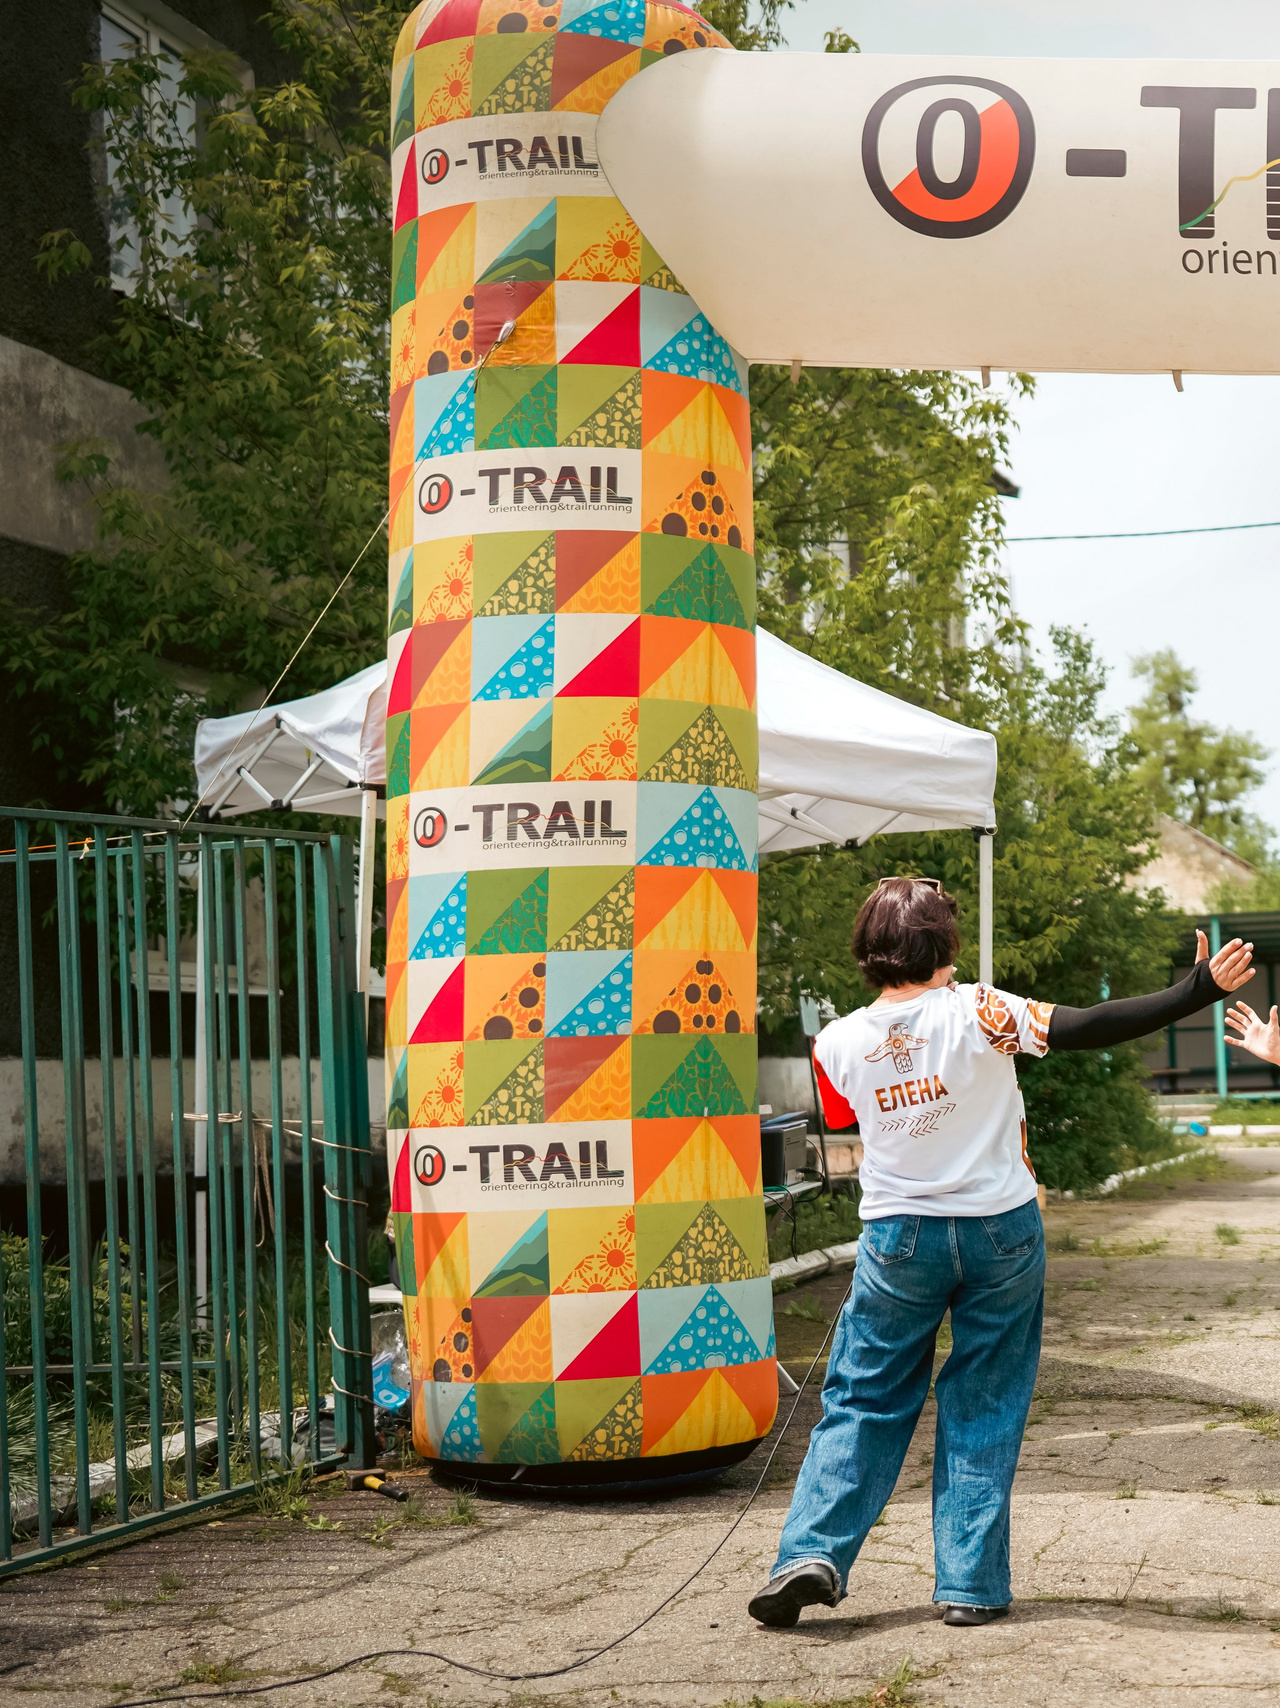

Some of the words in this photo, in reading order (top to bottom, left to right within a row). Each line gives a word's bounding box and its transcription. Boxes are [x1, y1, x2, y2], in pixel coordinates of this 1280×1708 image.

[479, 168, 599, 181] orienteering&trailrunning
[489, 502, 633, 514] orienteering&trailrunning
[483, 837, 627, 850] orienteering&trailrunning
[875, 1074, 949, 1113] ЕЛЕНА
[481, 1178, 625, 1191] orienteering&trailrunning
